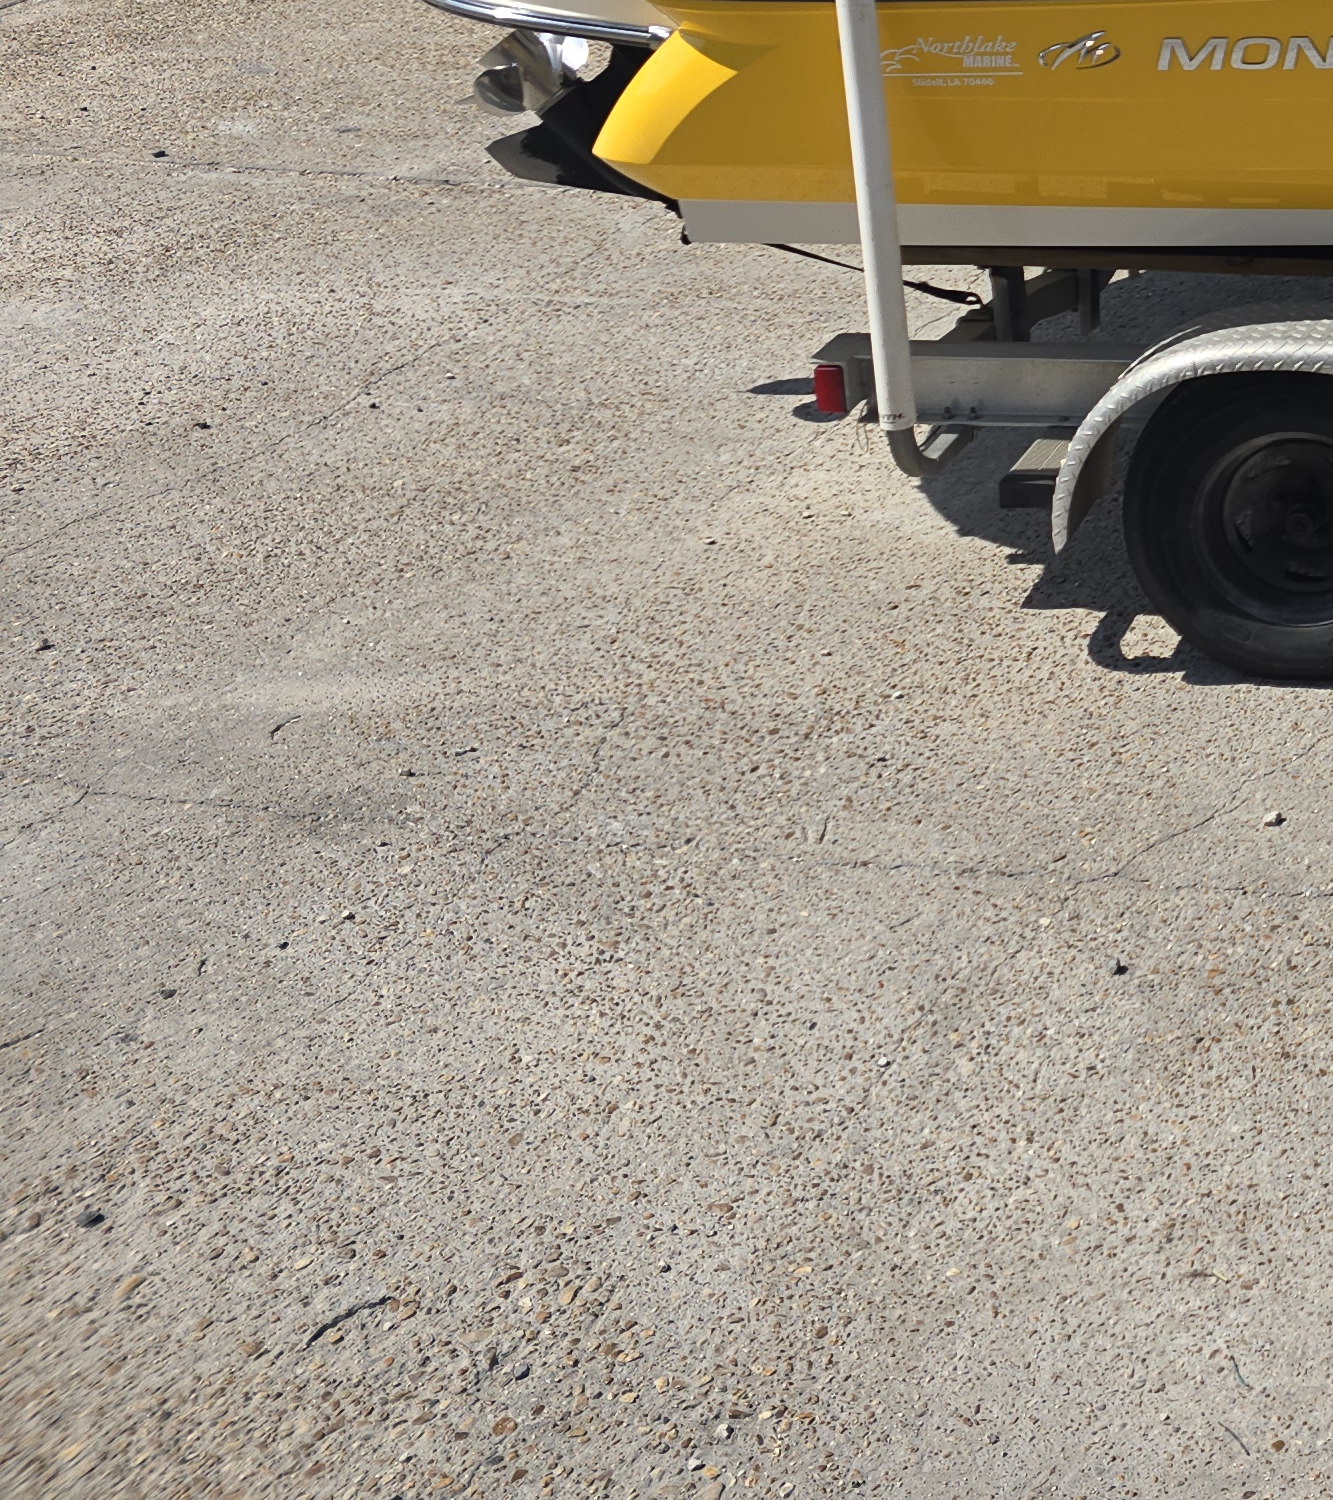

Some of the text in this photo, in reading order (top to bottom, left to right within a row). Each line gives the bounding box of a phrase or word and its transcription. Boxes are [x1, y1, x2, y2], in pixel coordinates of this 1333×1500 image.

[911, 35, 1017, 54] Northlake
[963, 55, 1012, 68] MARINE
[948, 78, 961, 86] LA
